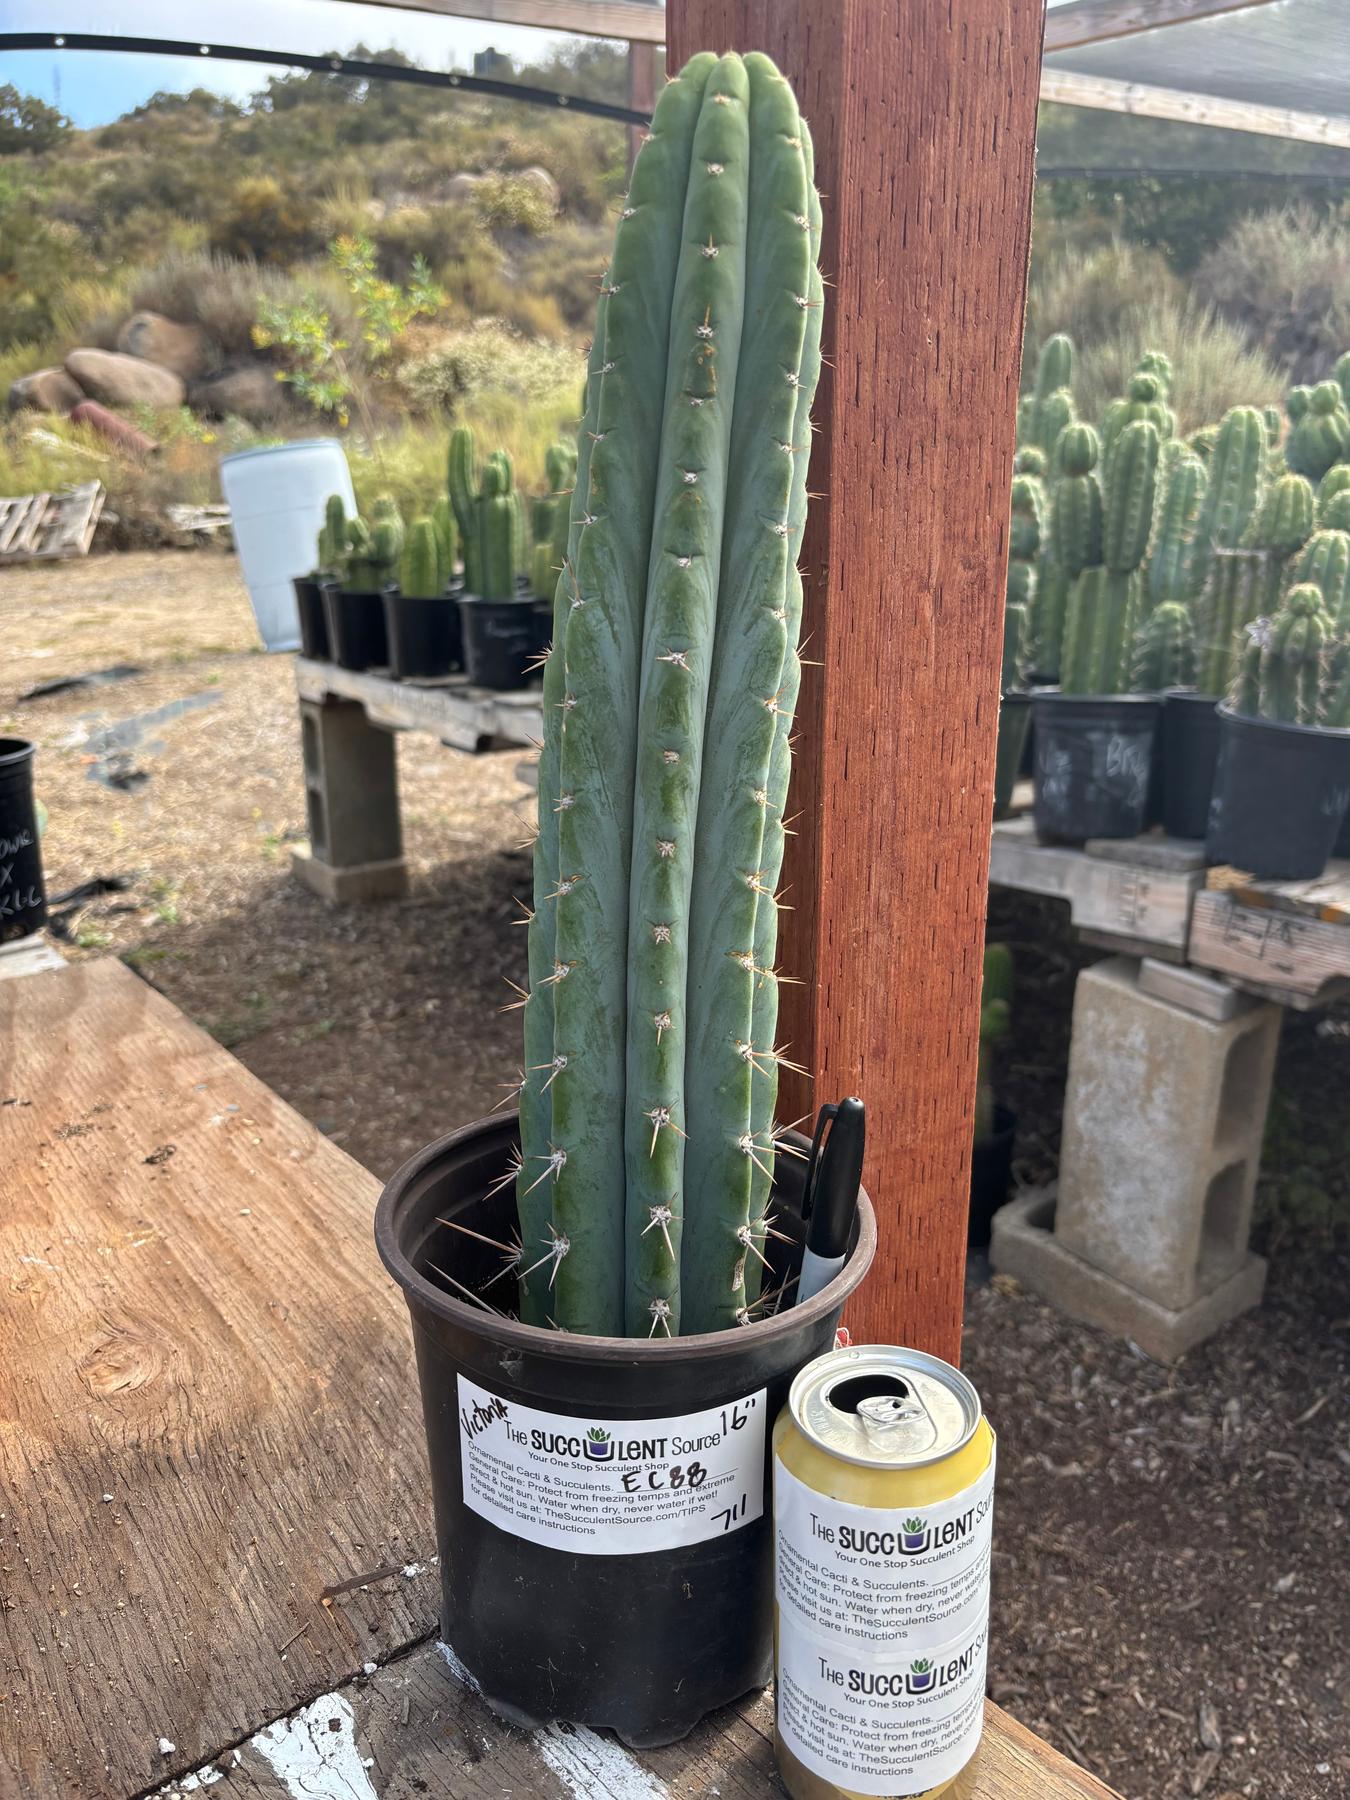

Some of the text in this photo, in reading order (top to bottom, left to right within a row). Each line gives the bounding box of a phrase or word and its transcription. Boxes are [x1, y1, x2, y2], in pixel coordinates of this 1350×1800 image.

[672, 1433, 721, 1456] Source
[468, 1440, 614, 1492] Ornamental Cacti & Succulents.
[528, 1451, 670, 1473] Your One Stop Succulent Shop
[468, 1451, 735, 1504] General Care: Protect from freezing temps and extreme
[469, 1463, 718, 1516] direct & hot sun. Water when dry, never water if wet!
[470, 1473, 706, 1525] Please visit us at: TheSucculentSource.com/TIPS
[471, 1484, 596, 1535] for detailed care instructions
[835, 1550, 857, 1564] Your
[860, 1557, 881, 1568] One
[884, 1559, 908, 1570] Stop
[910, 1550, 955, 1567] Succulent
[805, 1570, 830, 1590] Care:
[834, 1584, 873, 1602] Protect
[876, 1593, 902, 1603] from
[905, 1585, 948, 1602] freezing
[821, 1567, 848, 1583] Cacti
[851, 1577, 860, 1587] &
[863, 1579, 929, 1591] Succulents.
[801, 1592, 818, 1609] visit
[820, 1606, 832, 1616] us
[835, 1612, 848, 1621] at:
[803, 1581, 817, 1597] hot
[820, 1592, 841, 1607] sun.
[845, 1599, 878, 1615] Water
[881, 1606, 912, 1616] when
[915, 1602, 934, 1613] dry,
[938, 1589, 963, 1607] never
[819, 1618, 841, 1632] care
[844, 1624, 908, 1641] instructions
[844, 1692, 866, 1705] Your
[868, 1699, 890, 1709] One
[892, 1699, 915, 1710] Stop
[917, 1684, 958, 1705] Succulent
[812, 1710, 838, 1730] Care:
[841, 1724, 880, 1740] Protect
[884, 1732, 908, 1742] from
[912, 1720, 951, 1740] freezing
[829, 1708, 856, 1724] Cacti
[859, 1718, 867, 1727] &
[871, 1716, 934, 1730] Succulents.
[807, 1730, 825, 1747] visit
[828, 1743, 839, 1754] us
[843, 1750, 856, 1760] at:
[810, 1719, 825, 1735] hot
[828, 1733, 849, 1745] sun.
[852, 1739, 885, 1753] Water
[889, 1743, 918, 1753] when
[920, 1737, 938, 1749] dry,
[826, 1754, 848, 1768] care
[851, 1762, 914, 1777] instructions
